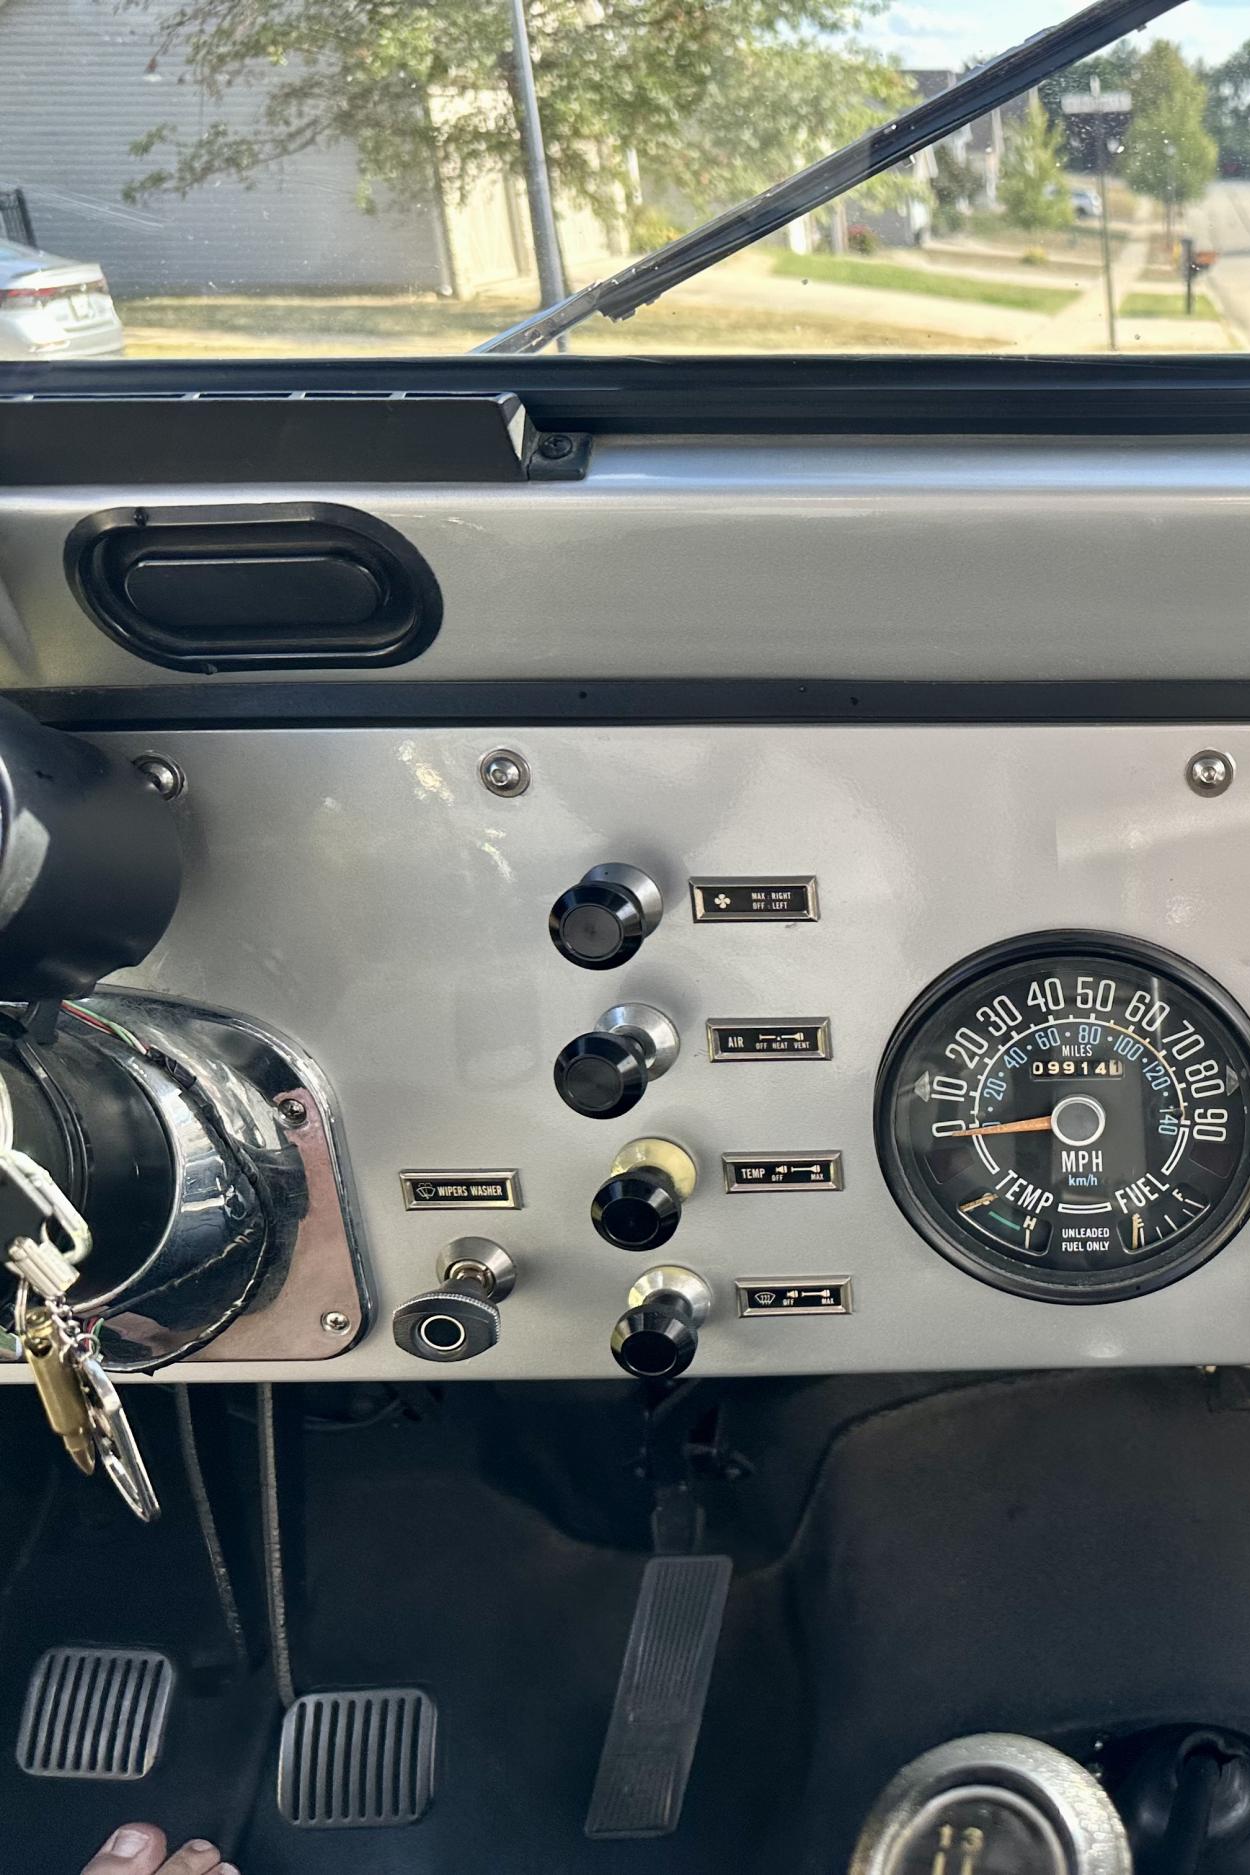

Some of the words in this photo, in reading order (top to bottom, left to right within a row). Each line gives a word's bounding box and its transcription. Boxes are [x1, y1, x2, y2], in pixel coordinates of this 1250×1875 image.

[751, 892, 766, 900] MAX
[771, 892, 791, 900] RIGHT
[772, 902, 788, 910] LEFT
[1026, 977, 1065, 1013] 40
[1076, 976, 1116, 1012] 50
[975, 995, 1023, 1037] 30
[1124, 990, 1171, 1033] 60
[728, 1036, 744, 1048] AIR
[772, 1042, 788, 1050] HEAT
[793, 1041, 810, 1049] VENT
[1035, 1027, 1061, 1050] 60
[1078, 1024, 1102, 1045] 80
[1161, 1019, 1205, 1061] 70
[945, 1027, 989, 1070] 20
[1003, 1046, 1028, 1069] 40
[1062, 1045, 1093, 1057] MILES
[1113, 1034, 1144, 1061] 100
[1142, 1060, 1171, 1091] 120
[1184, 1059, 1225, 1099] 80
[931, 1075, 968, 1101] 10
[983, 1078, 1007, 1101] 20
[931, 1119, 967, 1138] 0
[1158, 1107, 1179, 1136] 140
[1192, 1108, 1228, 1142] 90
[1061, 1150, 1103, 1173] MPH
[741, 1168, 766, 1179] TEMP
[810, 1173, 824, 1181] MAX
[1068, 1174, 1098, 1187] km/h
[436, 1186, 468, 1197] WIPERS
[469, 1185, 503, 1196] WASHER
[995, 1169, 1054, 1214] TEMP
[1115, 1172, 1170, 1214] FUEL
[1172, 1188, 1184, 1202] F
[1022, 1215, 1038, 1231] H
[1062, 1228, 1110, 1238] UNLEADED
[1062, 1241, 1086, 1251] FUEL
[1086, 1241, 1110, 1251] ONLY
